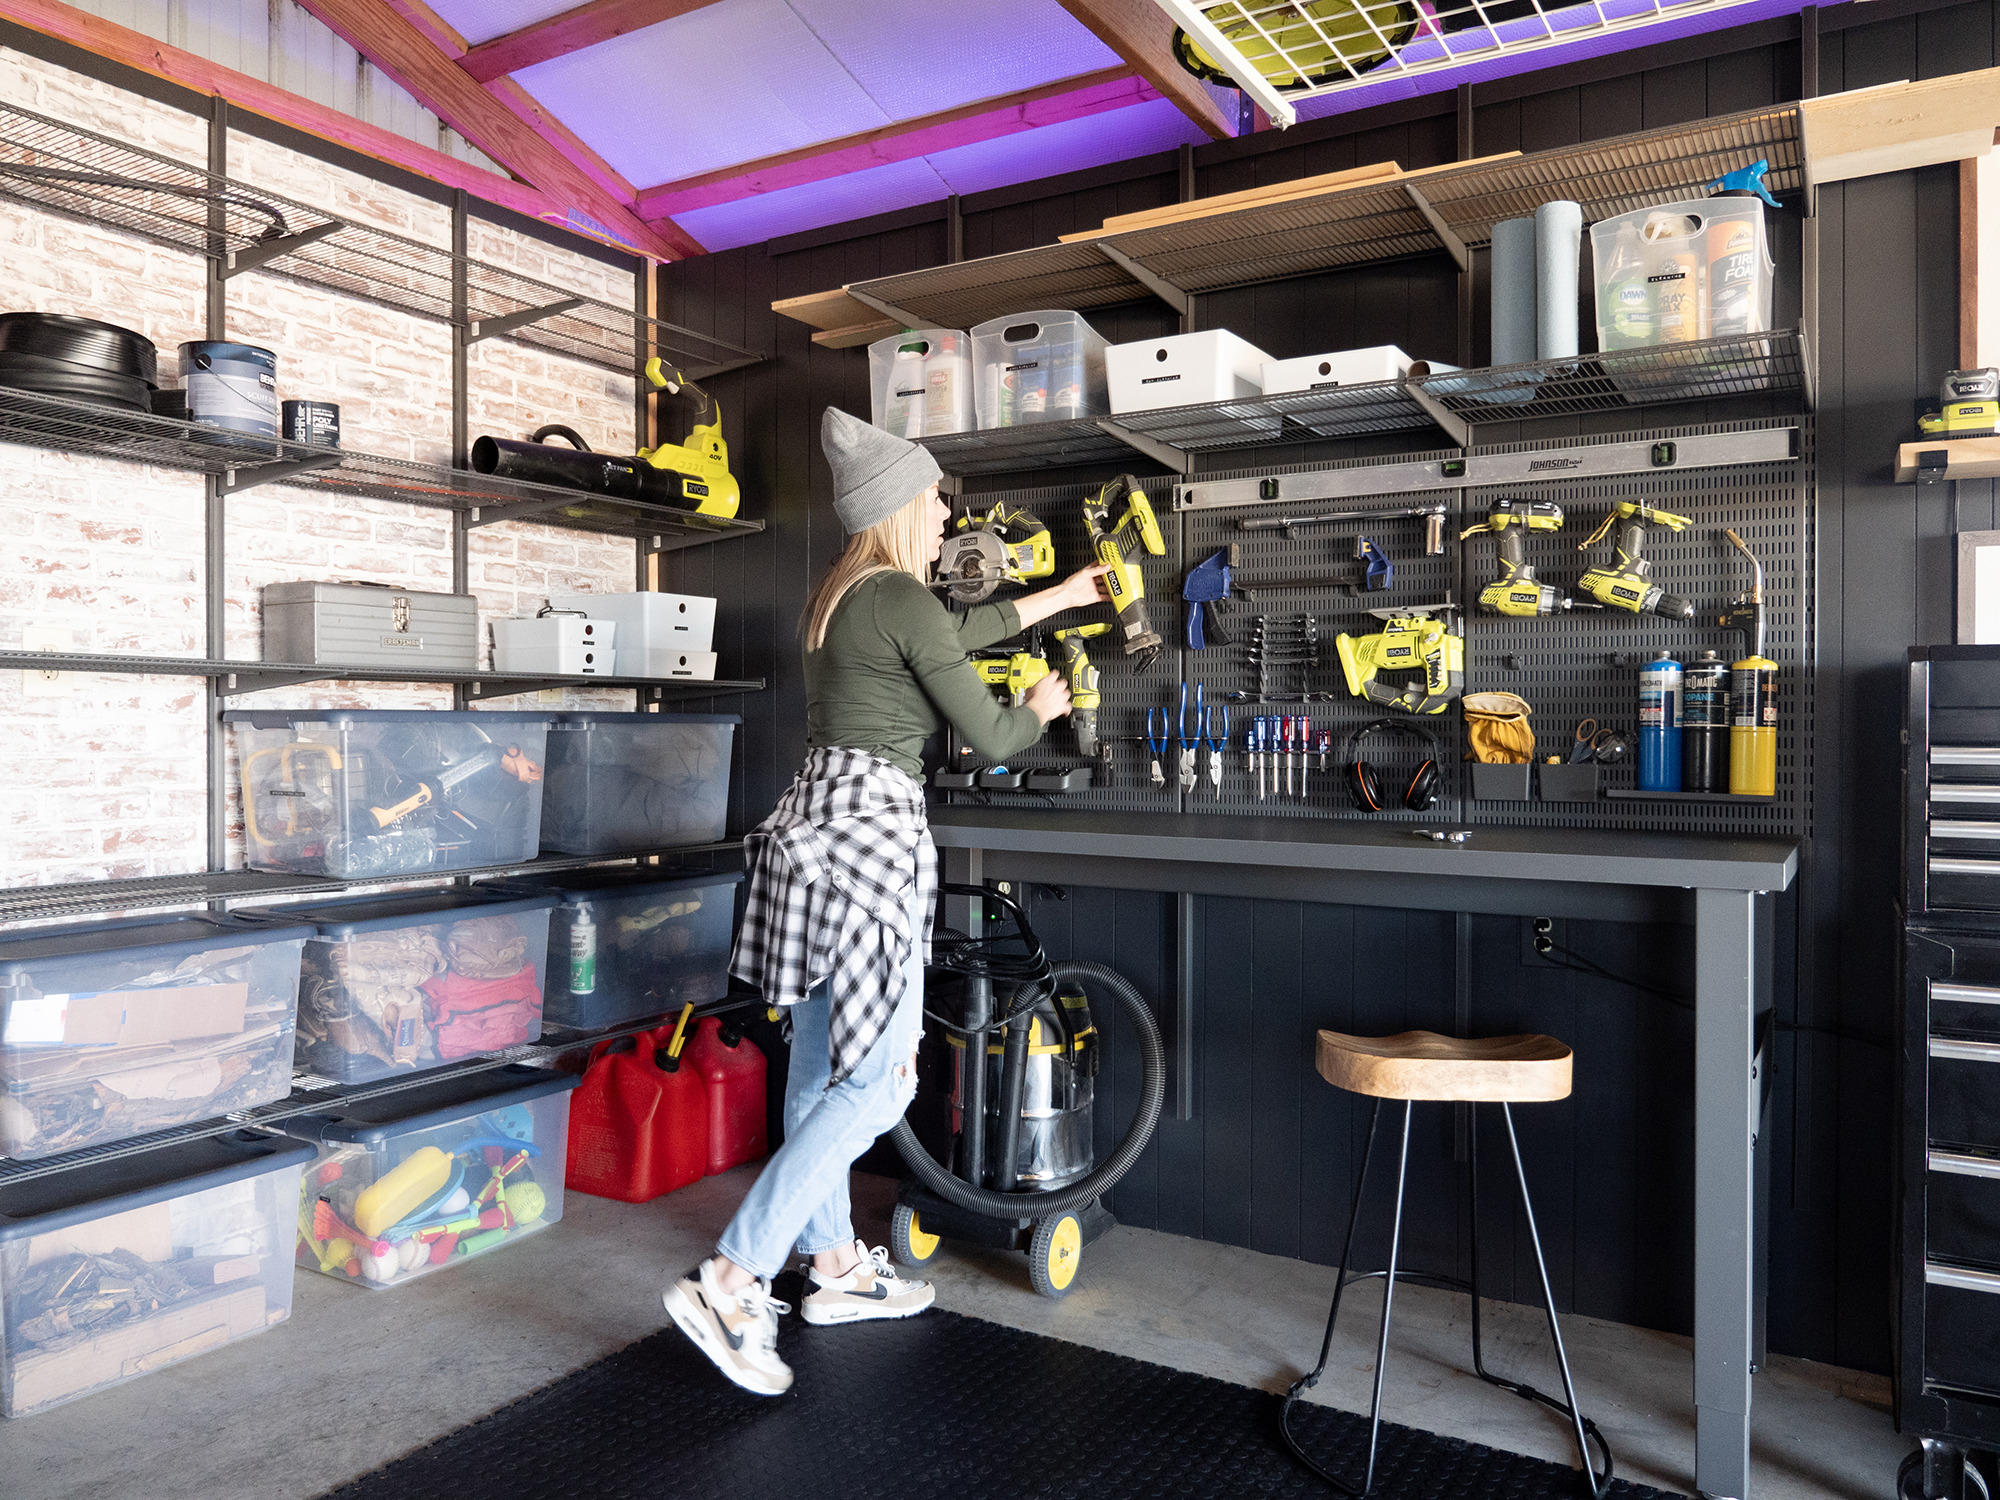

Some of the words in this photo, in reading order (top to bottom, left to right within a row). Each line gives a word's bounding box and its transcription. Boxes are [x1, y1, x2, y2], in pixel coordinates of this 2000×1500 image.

[1729, 253, 1753, 268] TIRE
[1651, 273, 1683, 282] CLEANING
[1724, 265, 1753, 282] FOA
[1619, 291, 1648, 301] DAWN
[1659, 293, 1686, 305] PRAY
[1960, 384, 1984, 393] RYOBI
[248, 391, 268, 402] SCUFF
[313, 416, 332, 425] POLY
[709, 453, 722, 461] 40V
[1528, 458, 1570, 472] JOHNSON
[688, 483, 708, 496] RYOBI
[960, 537, 977, 546] RYOBI
[1107, 571, 1122, 596] RYOBI
[1611, 585, 1640, 600] RYOBI
[1511, 593, 1536, 603] RYOBI
[384, 637, 420, 647] CRAFTSMAN
[1387, 647, 1410, 656] RYOBI
[988, 666, 1006, 674] RYOBI
